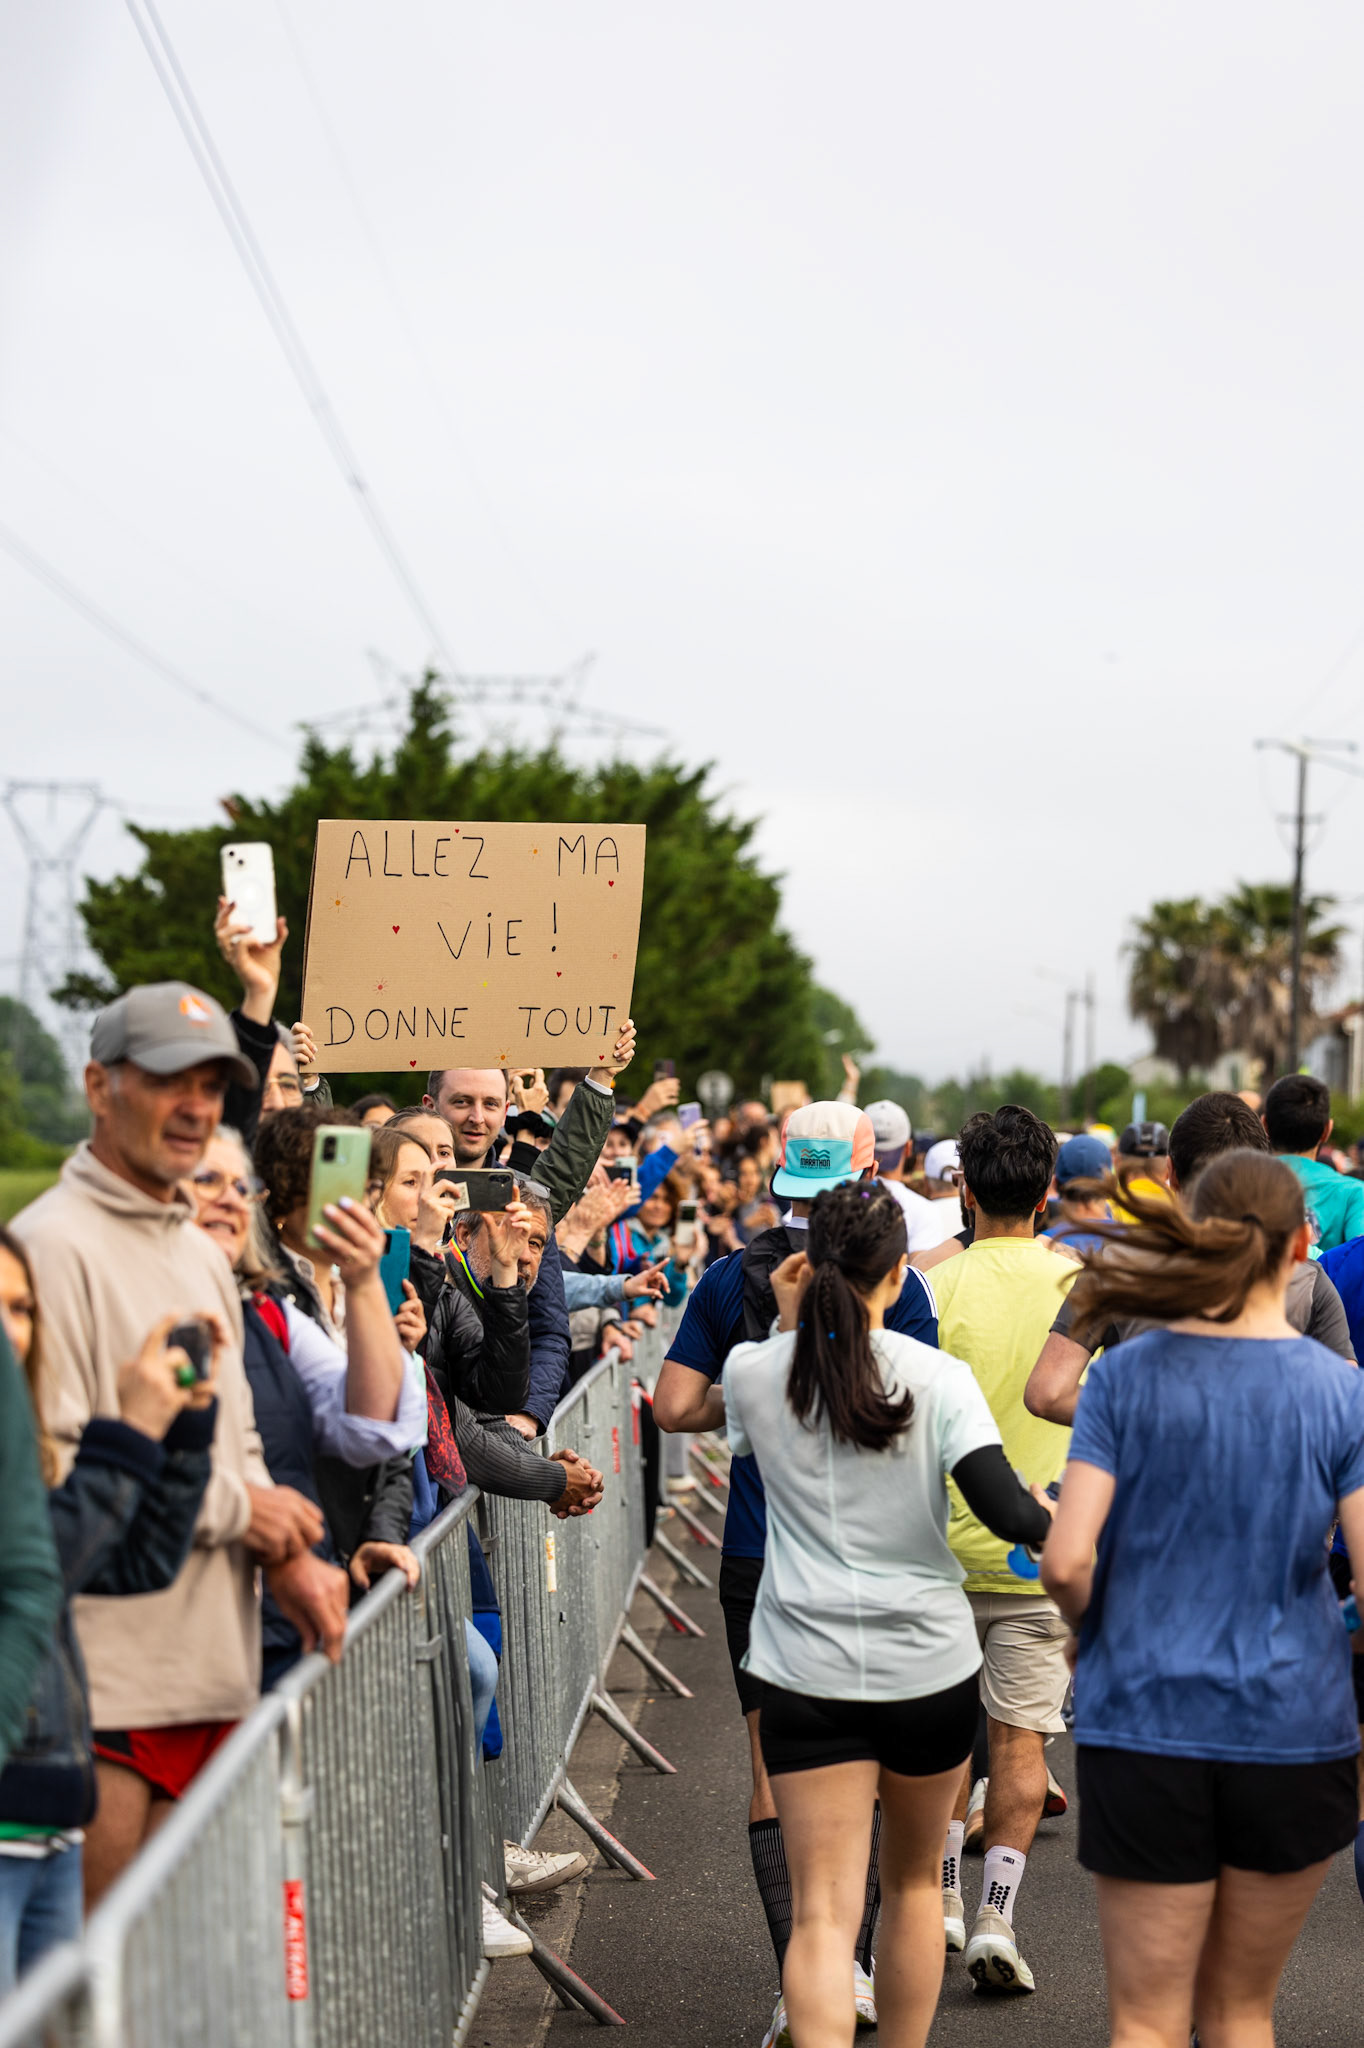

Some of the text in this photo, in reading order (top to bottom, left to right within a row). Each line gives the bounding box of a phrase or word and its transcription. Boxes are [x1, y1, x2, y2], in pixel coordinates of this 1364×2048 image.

[345, 829, 620, 879] ALLEZ MA
[324, 1005, 617, 1046] DONNE TOUT
[800, 1157, 831, 1167] MARATHON
